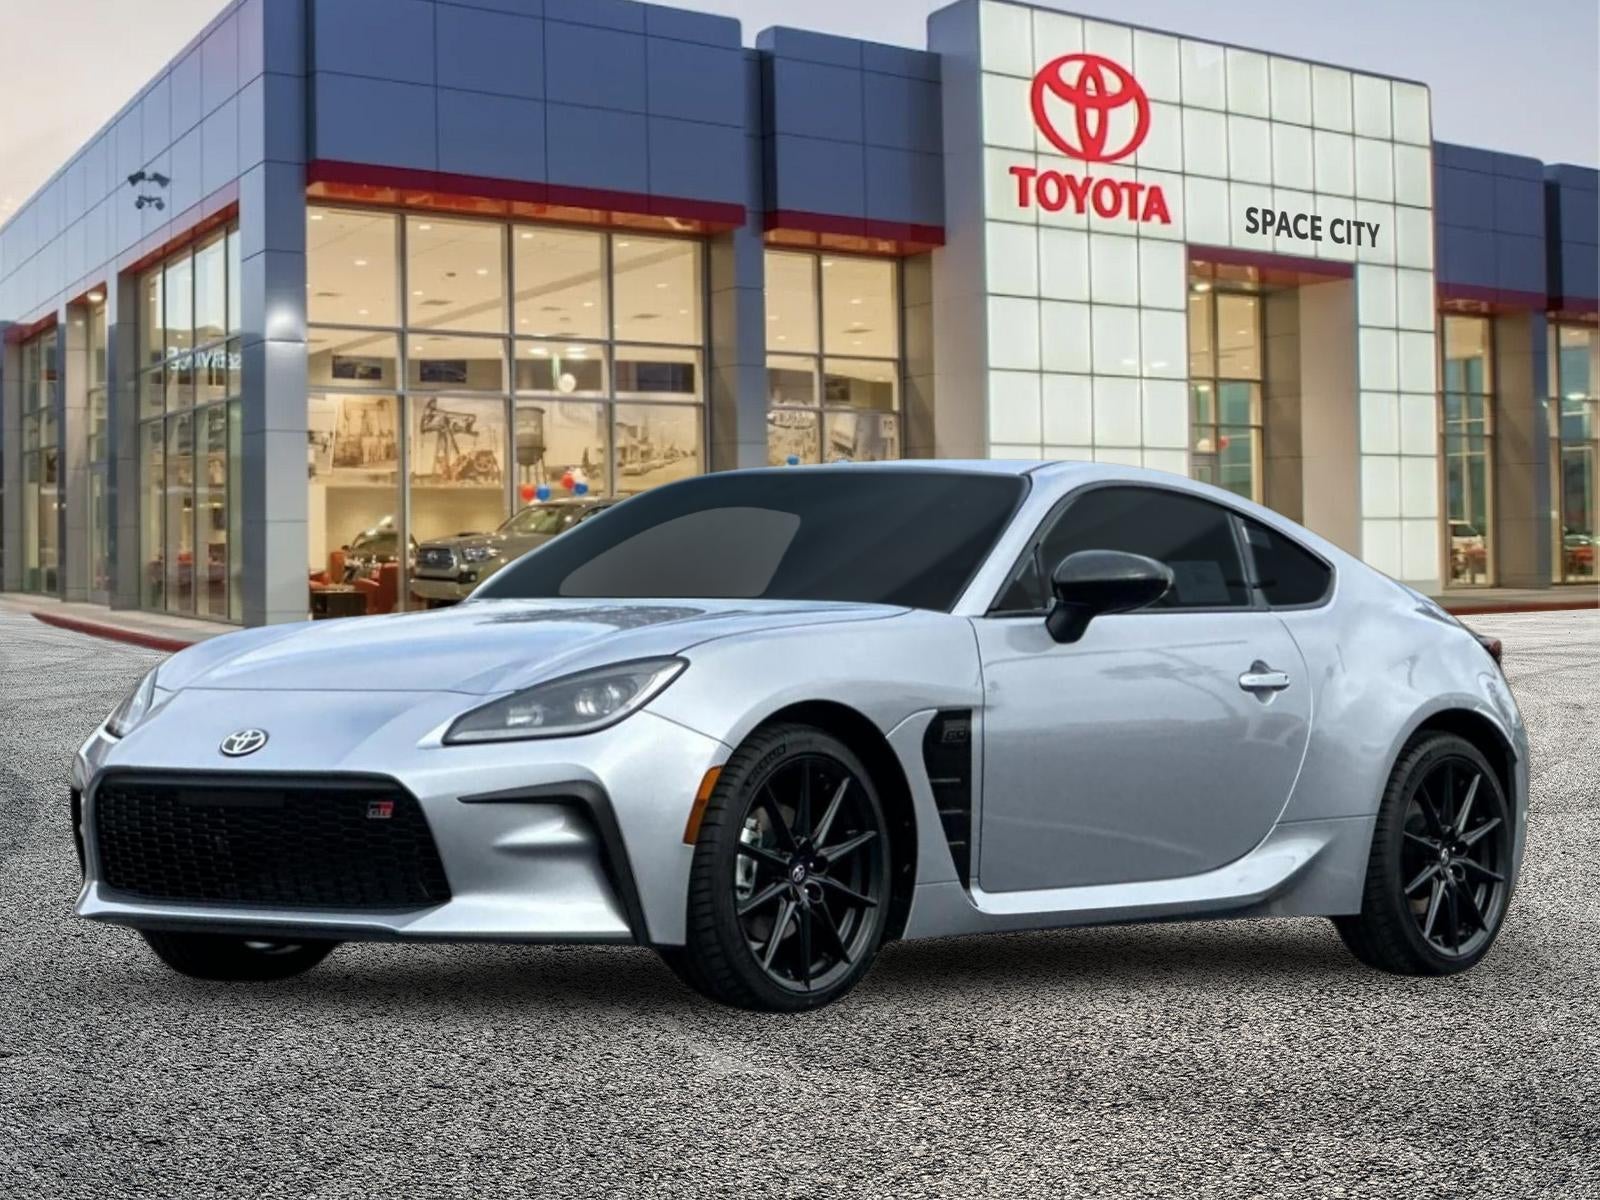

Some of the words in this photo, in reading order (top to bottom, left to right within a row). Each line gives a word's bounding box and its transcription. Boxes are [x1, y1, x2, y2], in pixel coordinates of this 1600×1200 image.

[1010, 165, 1171, 224] TOYOTA
[1245, 206, 1323, 242] SPACE
[1329, 218, 1381, 248] CITY
